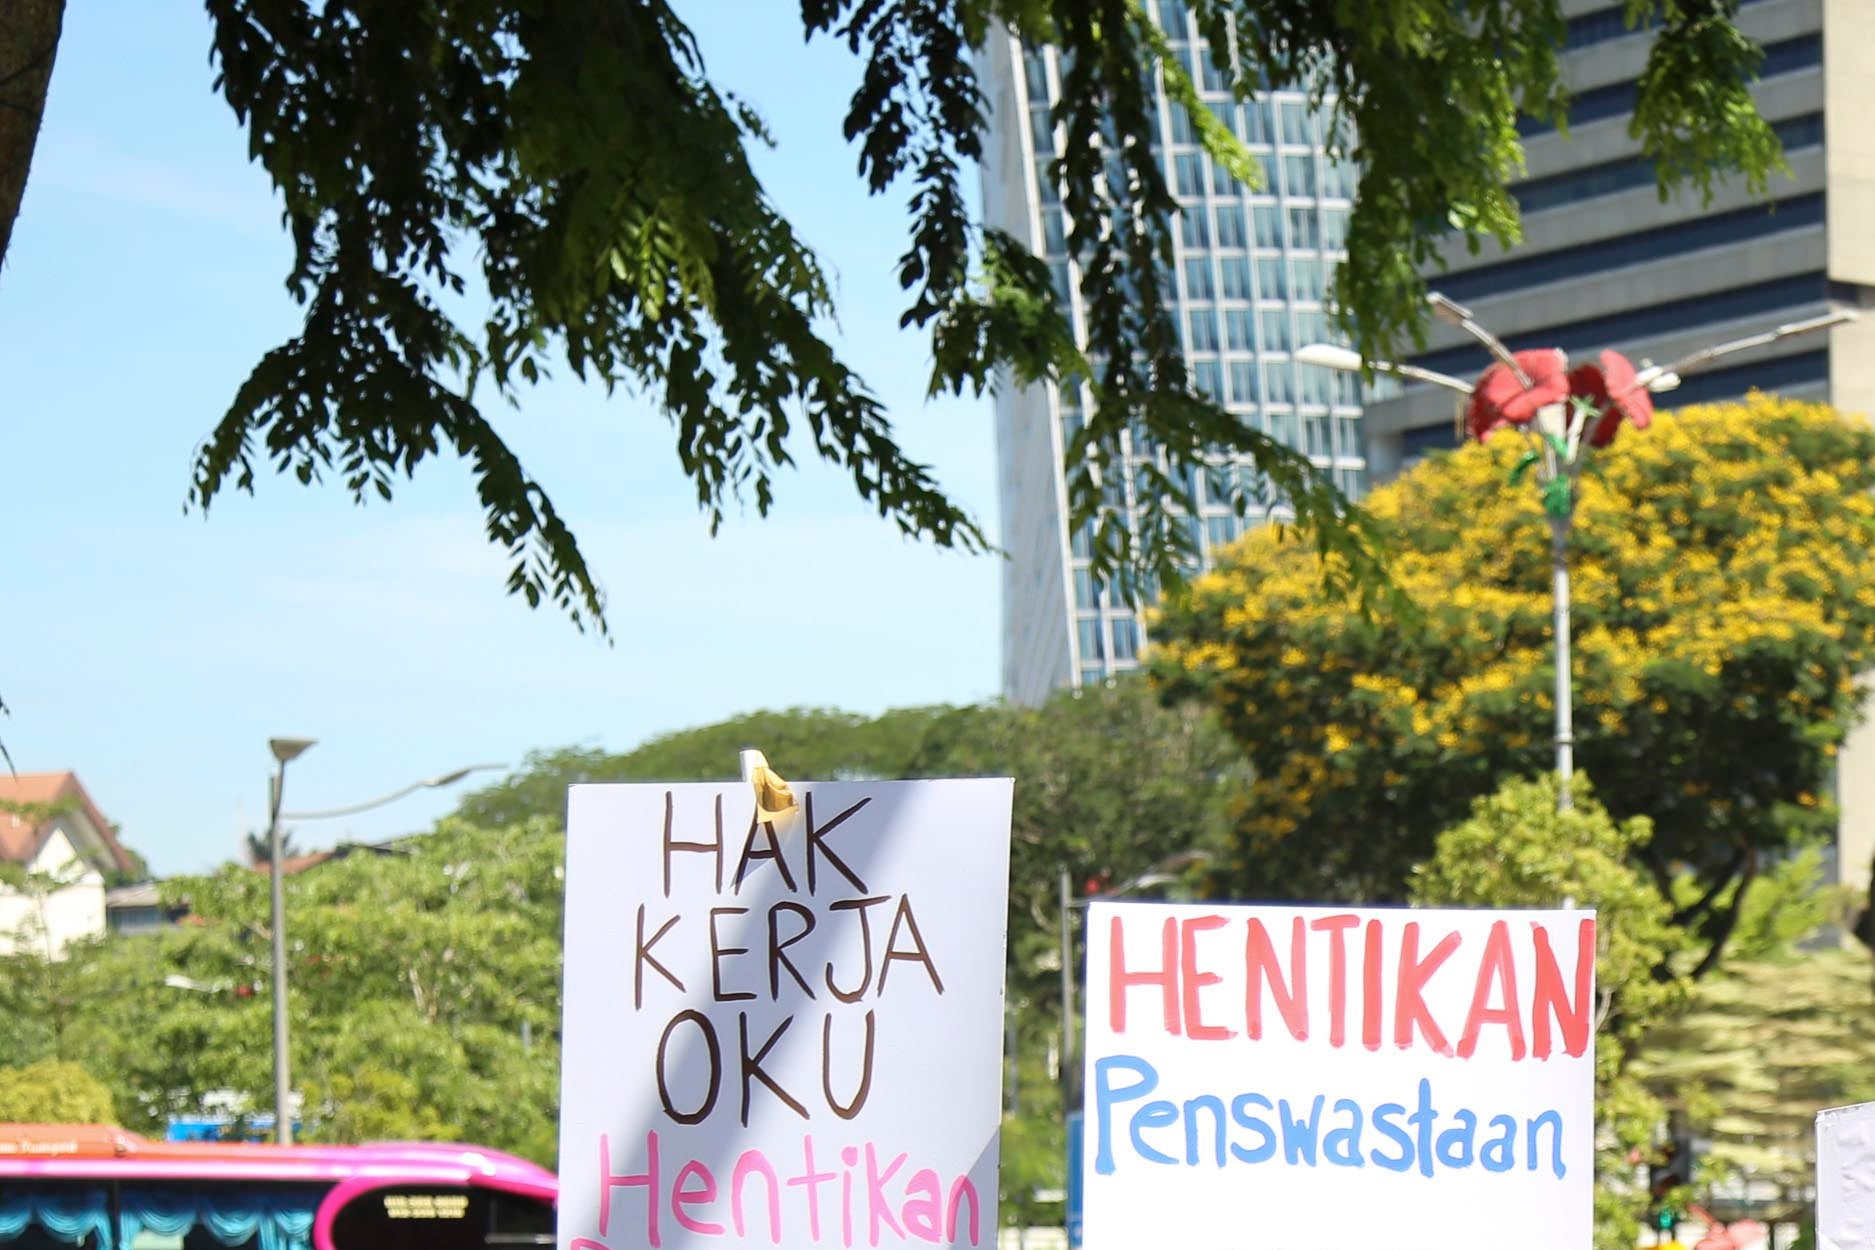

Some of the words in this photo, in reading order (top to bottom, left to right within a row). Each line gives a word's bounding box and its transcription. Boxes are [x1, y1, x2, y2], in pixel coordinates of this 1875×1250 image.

[664, 791, 873, 898] HAK
[634, 893, 944, 1011] KERJA
[1109, 914, 1596, 1061] HENTIKAN
[656, 1008, 875, 1128] OKU
[1095, 1055, 1566, 1179] Penswastaan
[598, 1129, 981, 1249] Hentikan
